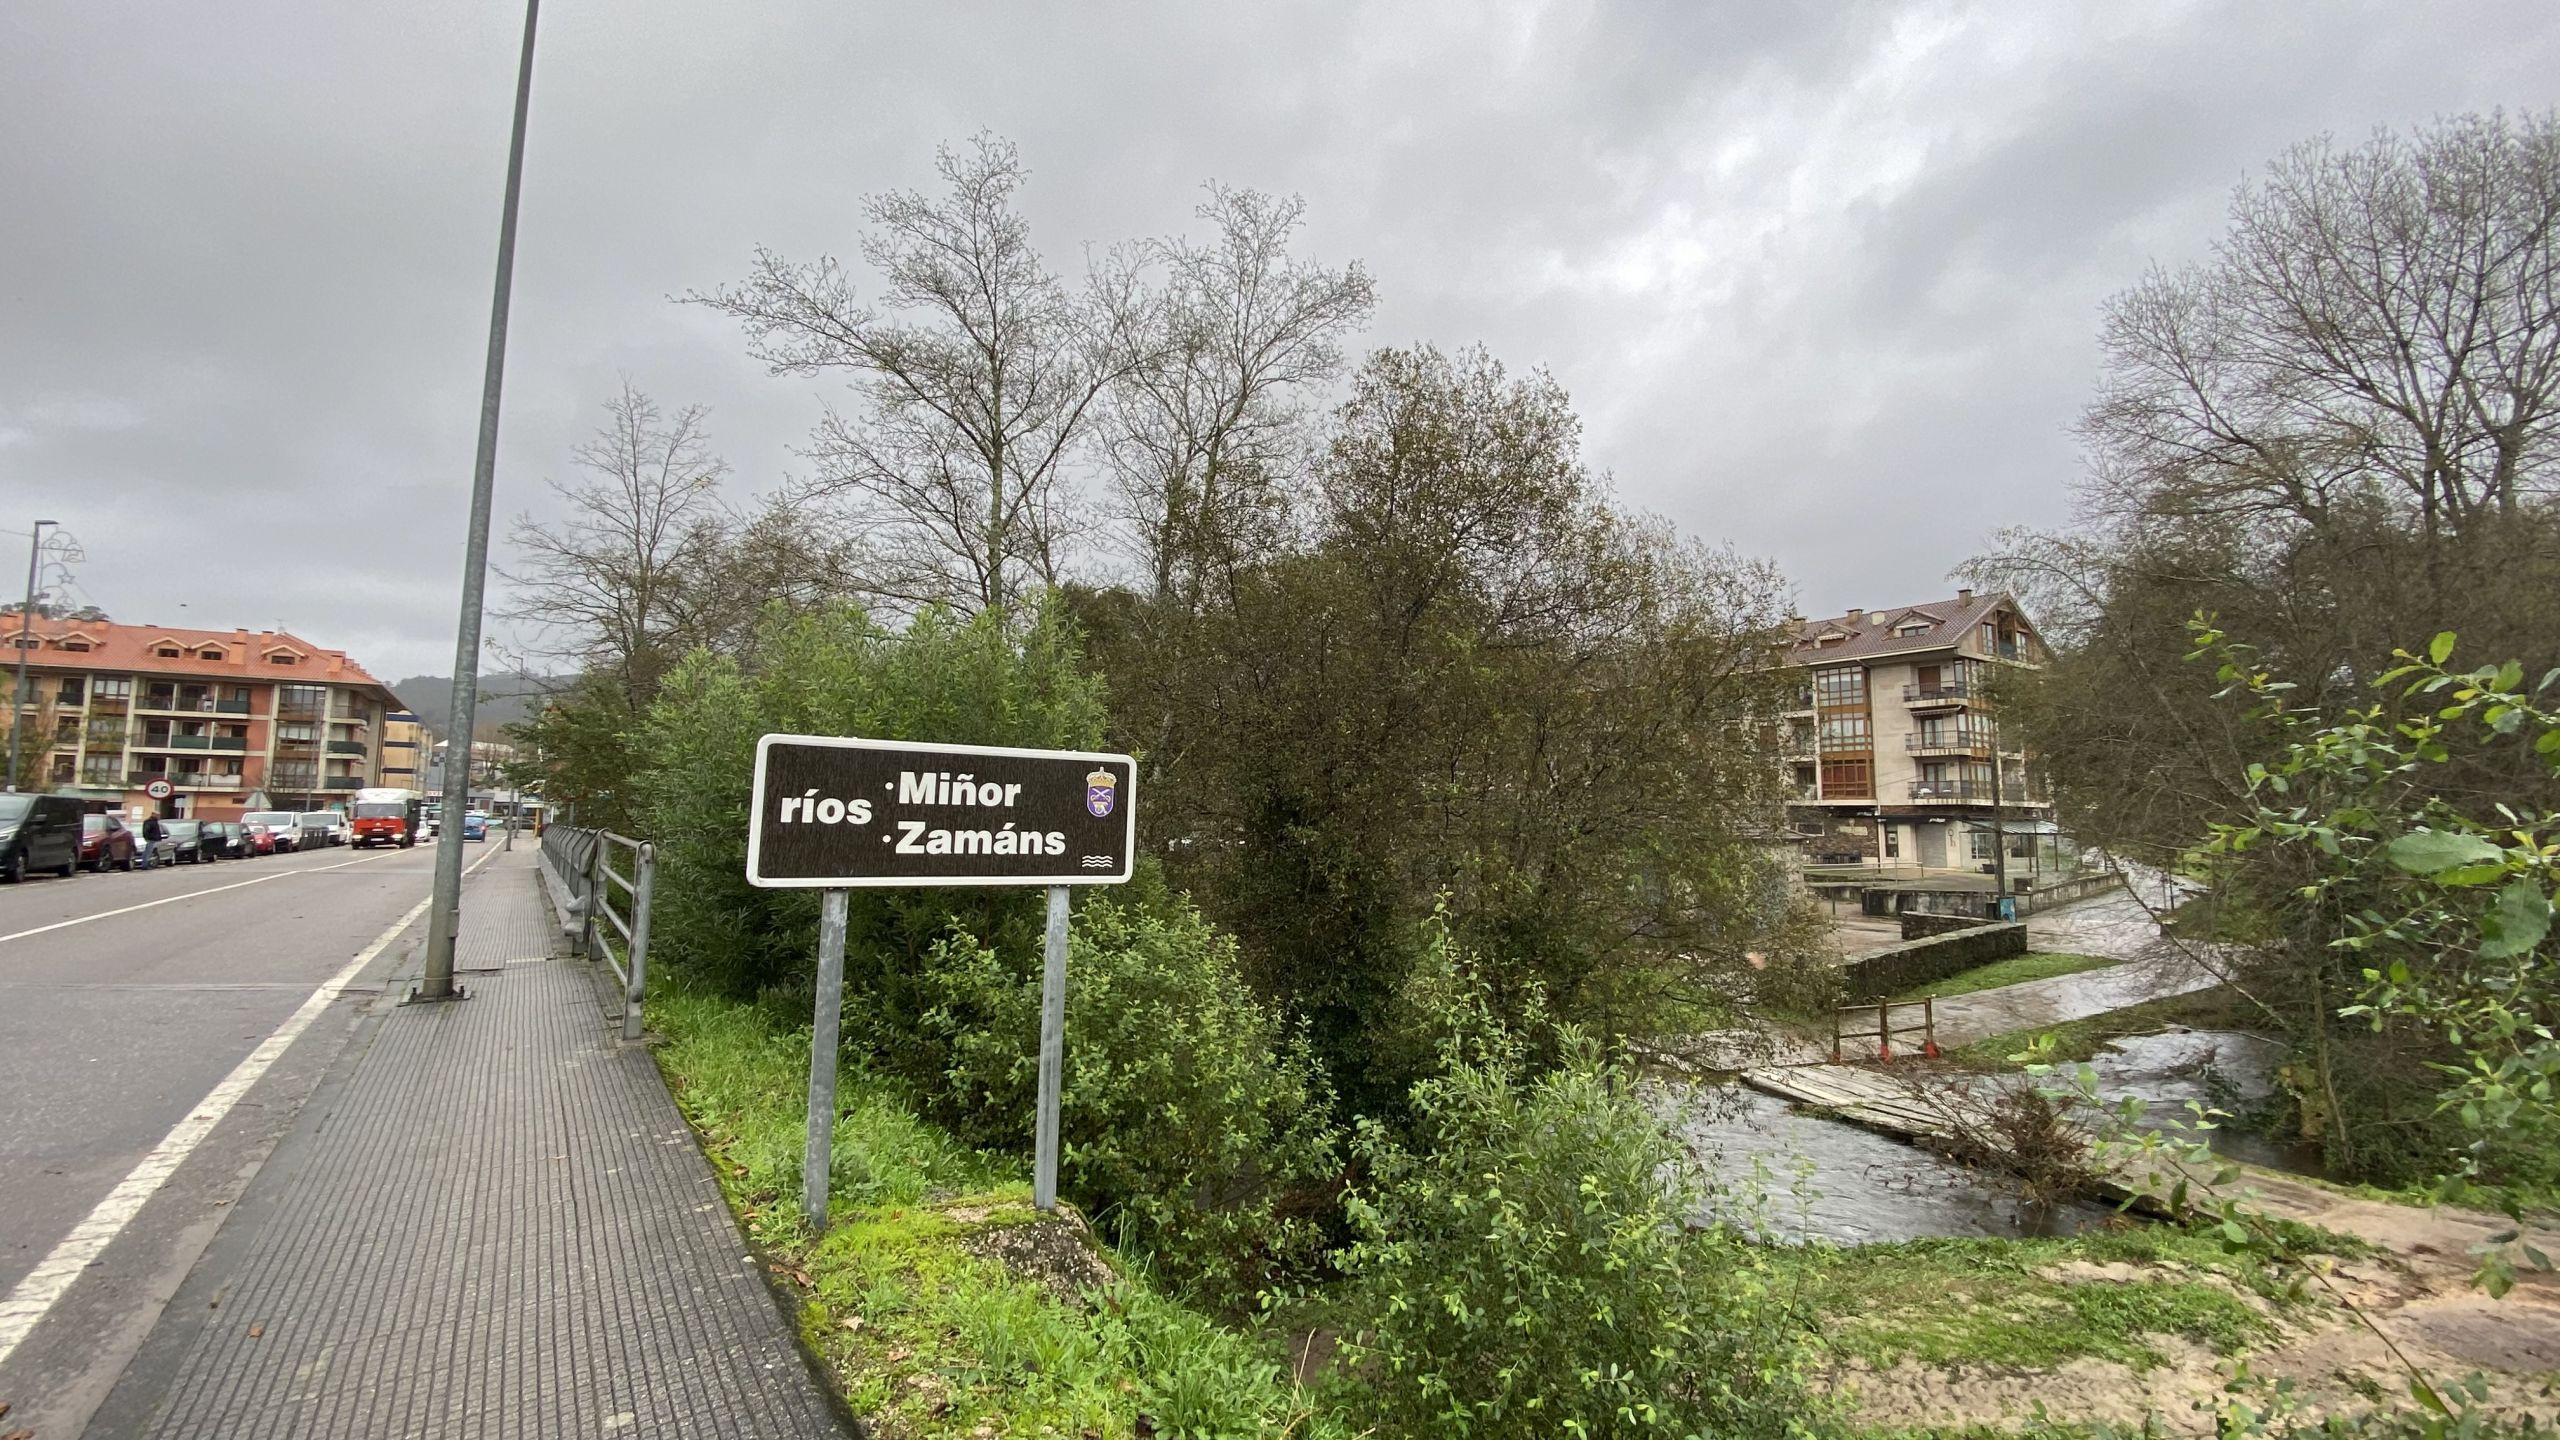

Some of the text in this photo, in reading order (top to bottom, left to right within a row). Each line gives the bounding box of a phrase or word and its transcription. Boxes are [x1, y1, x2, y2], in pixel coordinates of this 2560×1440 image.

[779, 788, 873, 824] ríos
[898, 771, 1021, 806] Miñor
[895, 820, 1067, 856] Zamáns
